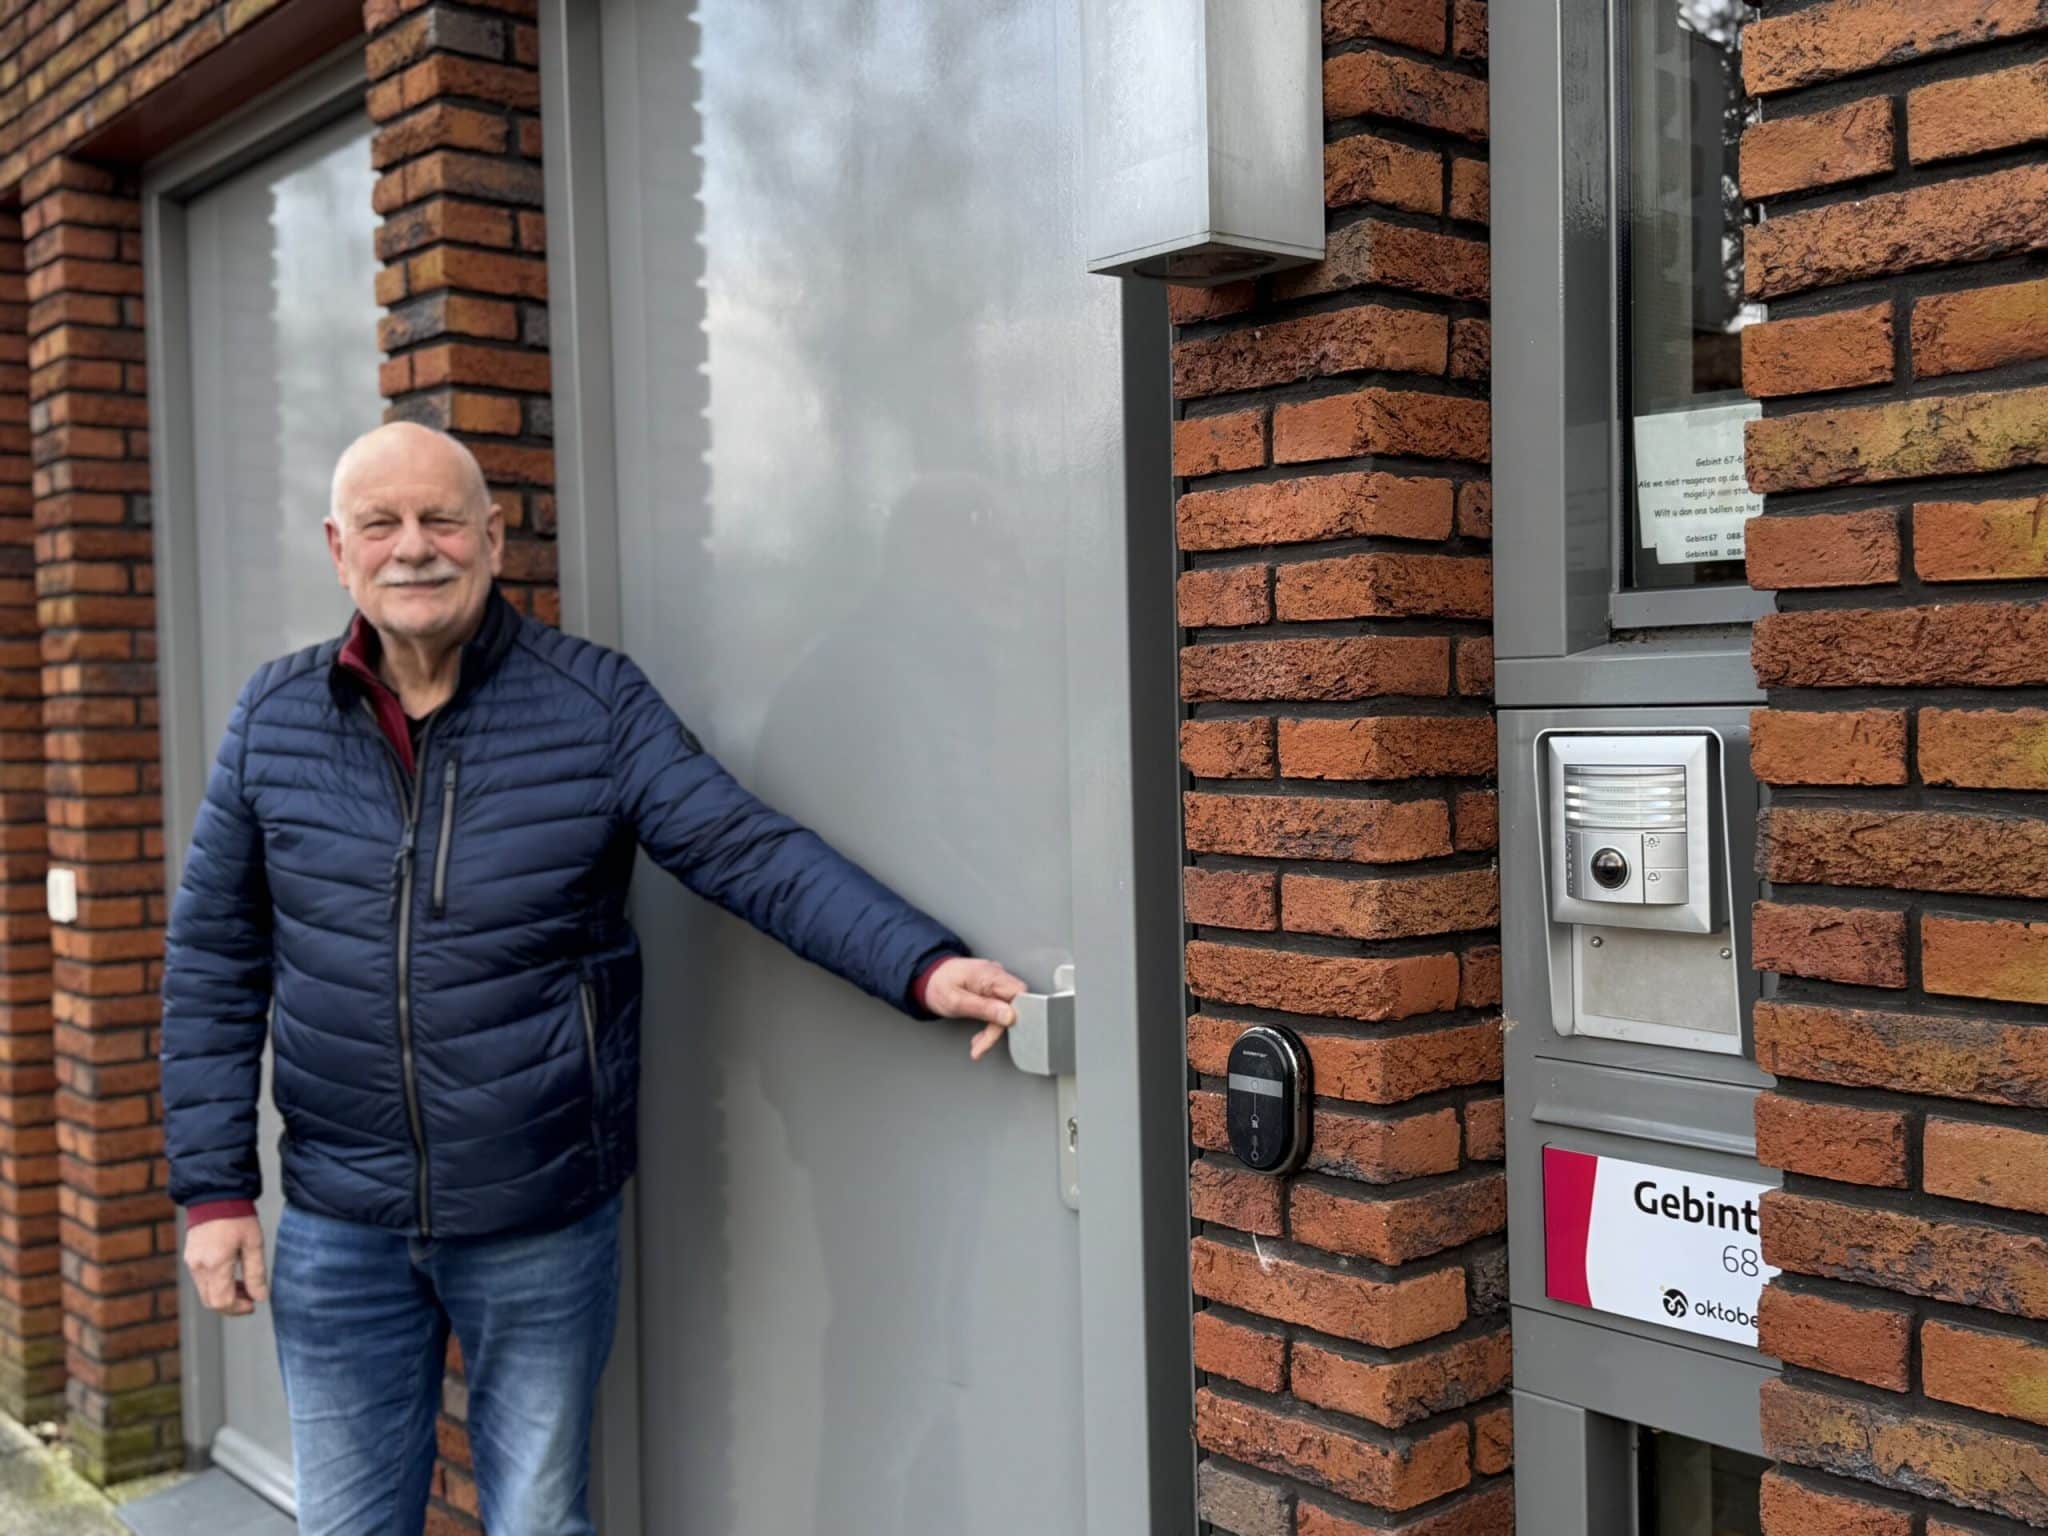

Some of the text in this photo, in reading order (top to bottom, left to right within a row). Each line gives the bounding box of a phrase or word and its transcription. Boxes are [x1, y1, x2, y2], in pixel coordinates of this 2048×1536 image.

[1718, 475, 1728, 484] op
[1729, 473, 1740, 481] de
[1746, 503, 1760, 512] het
[1633, 1180, 1758, 1235] Gebint
[1722, 1245, 1759, 1277] 68
[1694, 1299, 1759, 1329] oktobe
